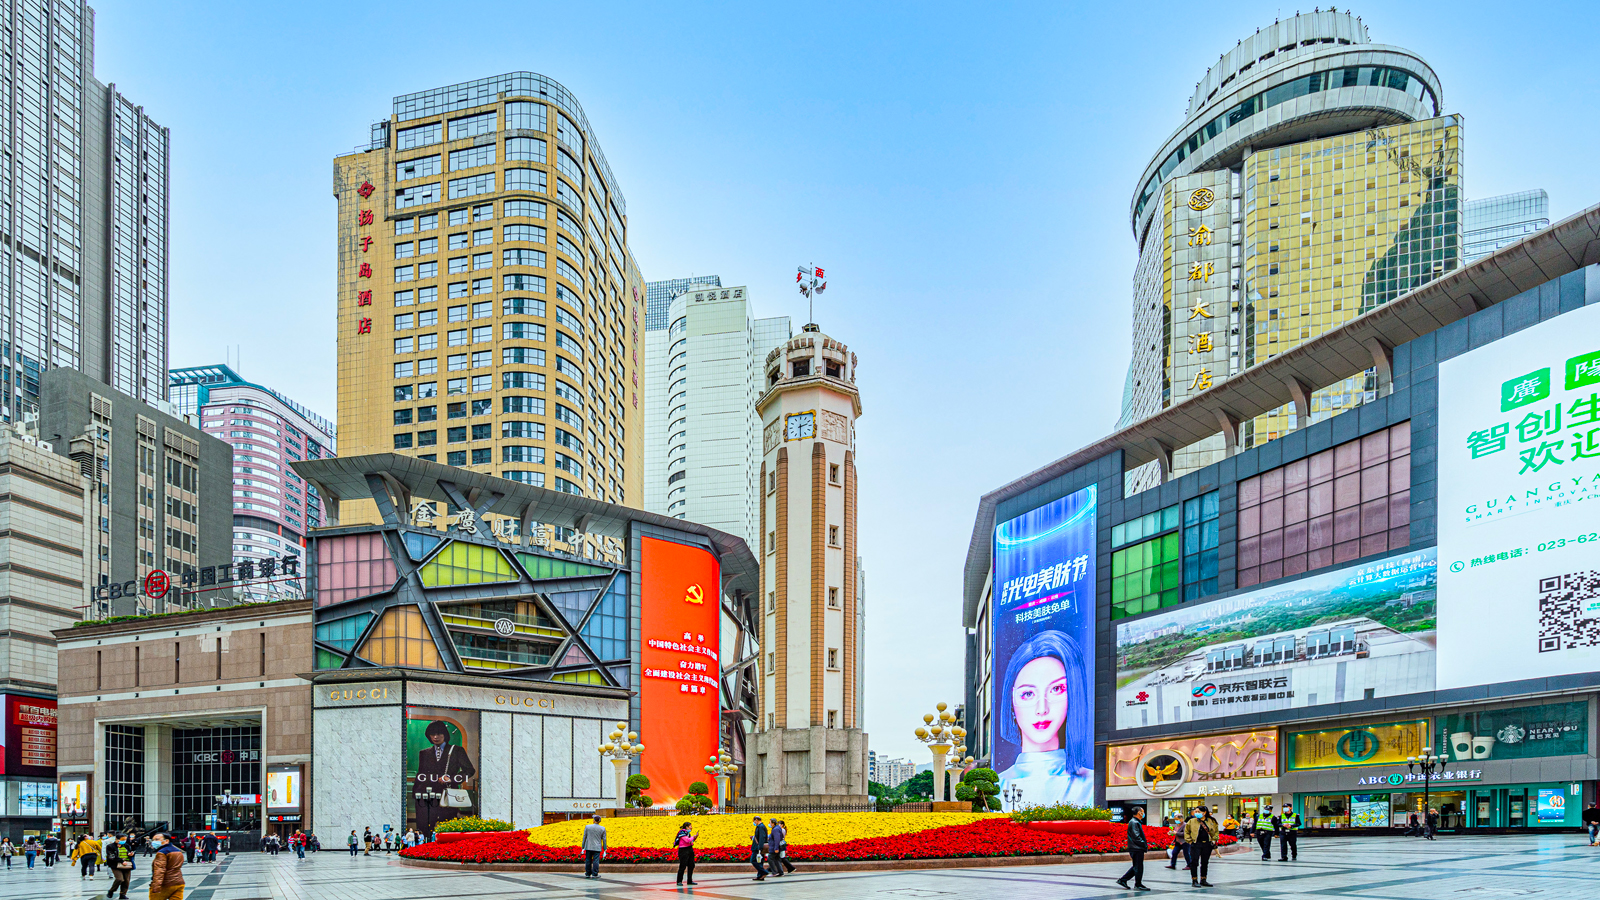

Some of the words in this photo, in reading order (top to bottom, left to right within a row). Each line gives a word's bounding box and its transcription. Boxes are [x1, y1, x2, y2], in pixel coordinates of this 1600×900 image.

[357, 209, 374, 335] 扬子岛酒店
[815, 266, 825, 279] 西
[1188, 223, 1214, 390] 渝都大酒店
[1466, 392, 1600, 460] 智创生
[1465, 505, 1513, 522] SMART
[410, 500, 620, 555] 金鹰财富中心
[1470, 548, 1528, 567] 热线电话：
[1537, 532, 1600, 552] 023-62
[181, 555, 298, 588] 中国工商银行
[91, 580, 136, 601] ICBC
[1015, 598, 1070, 624] 科技美肤免单
[1218, 676, 1288, 694] 京东智联云
[330, 687, 388, 701] GUCCI
[495, 695, 555, 710] GUCCI
[194, 753, 218, 762] ICBC
[240, 751, 262, 760] 中国
[417, 773, 469, 783] GUCCI
[1358, 776, 1387, 785] ABC
[1197, 784, 1235, 796] 周六福
